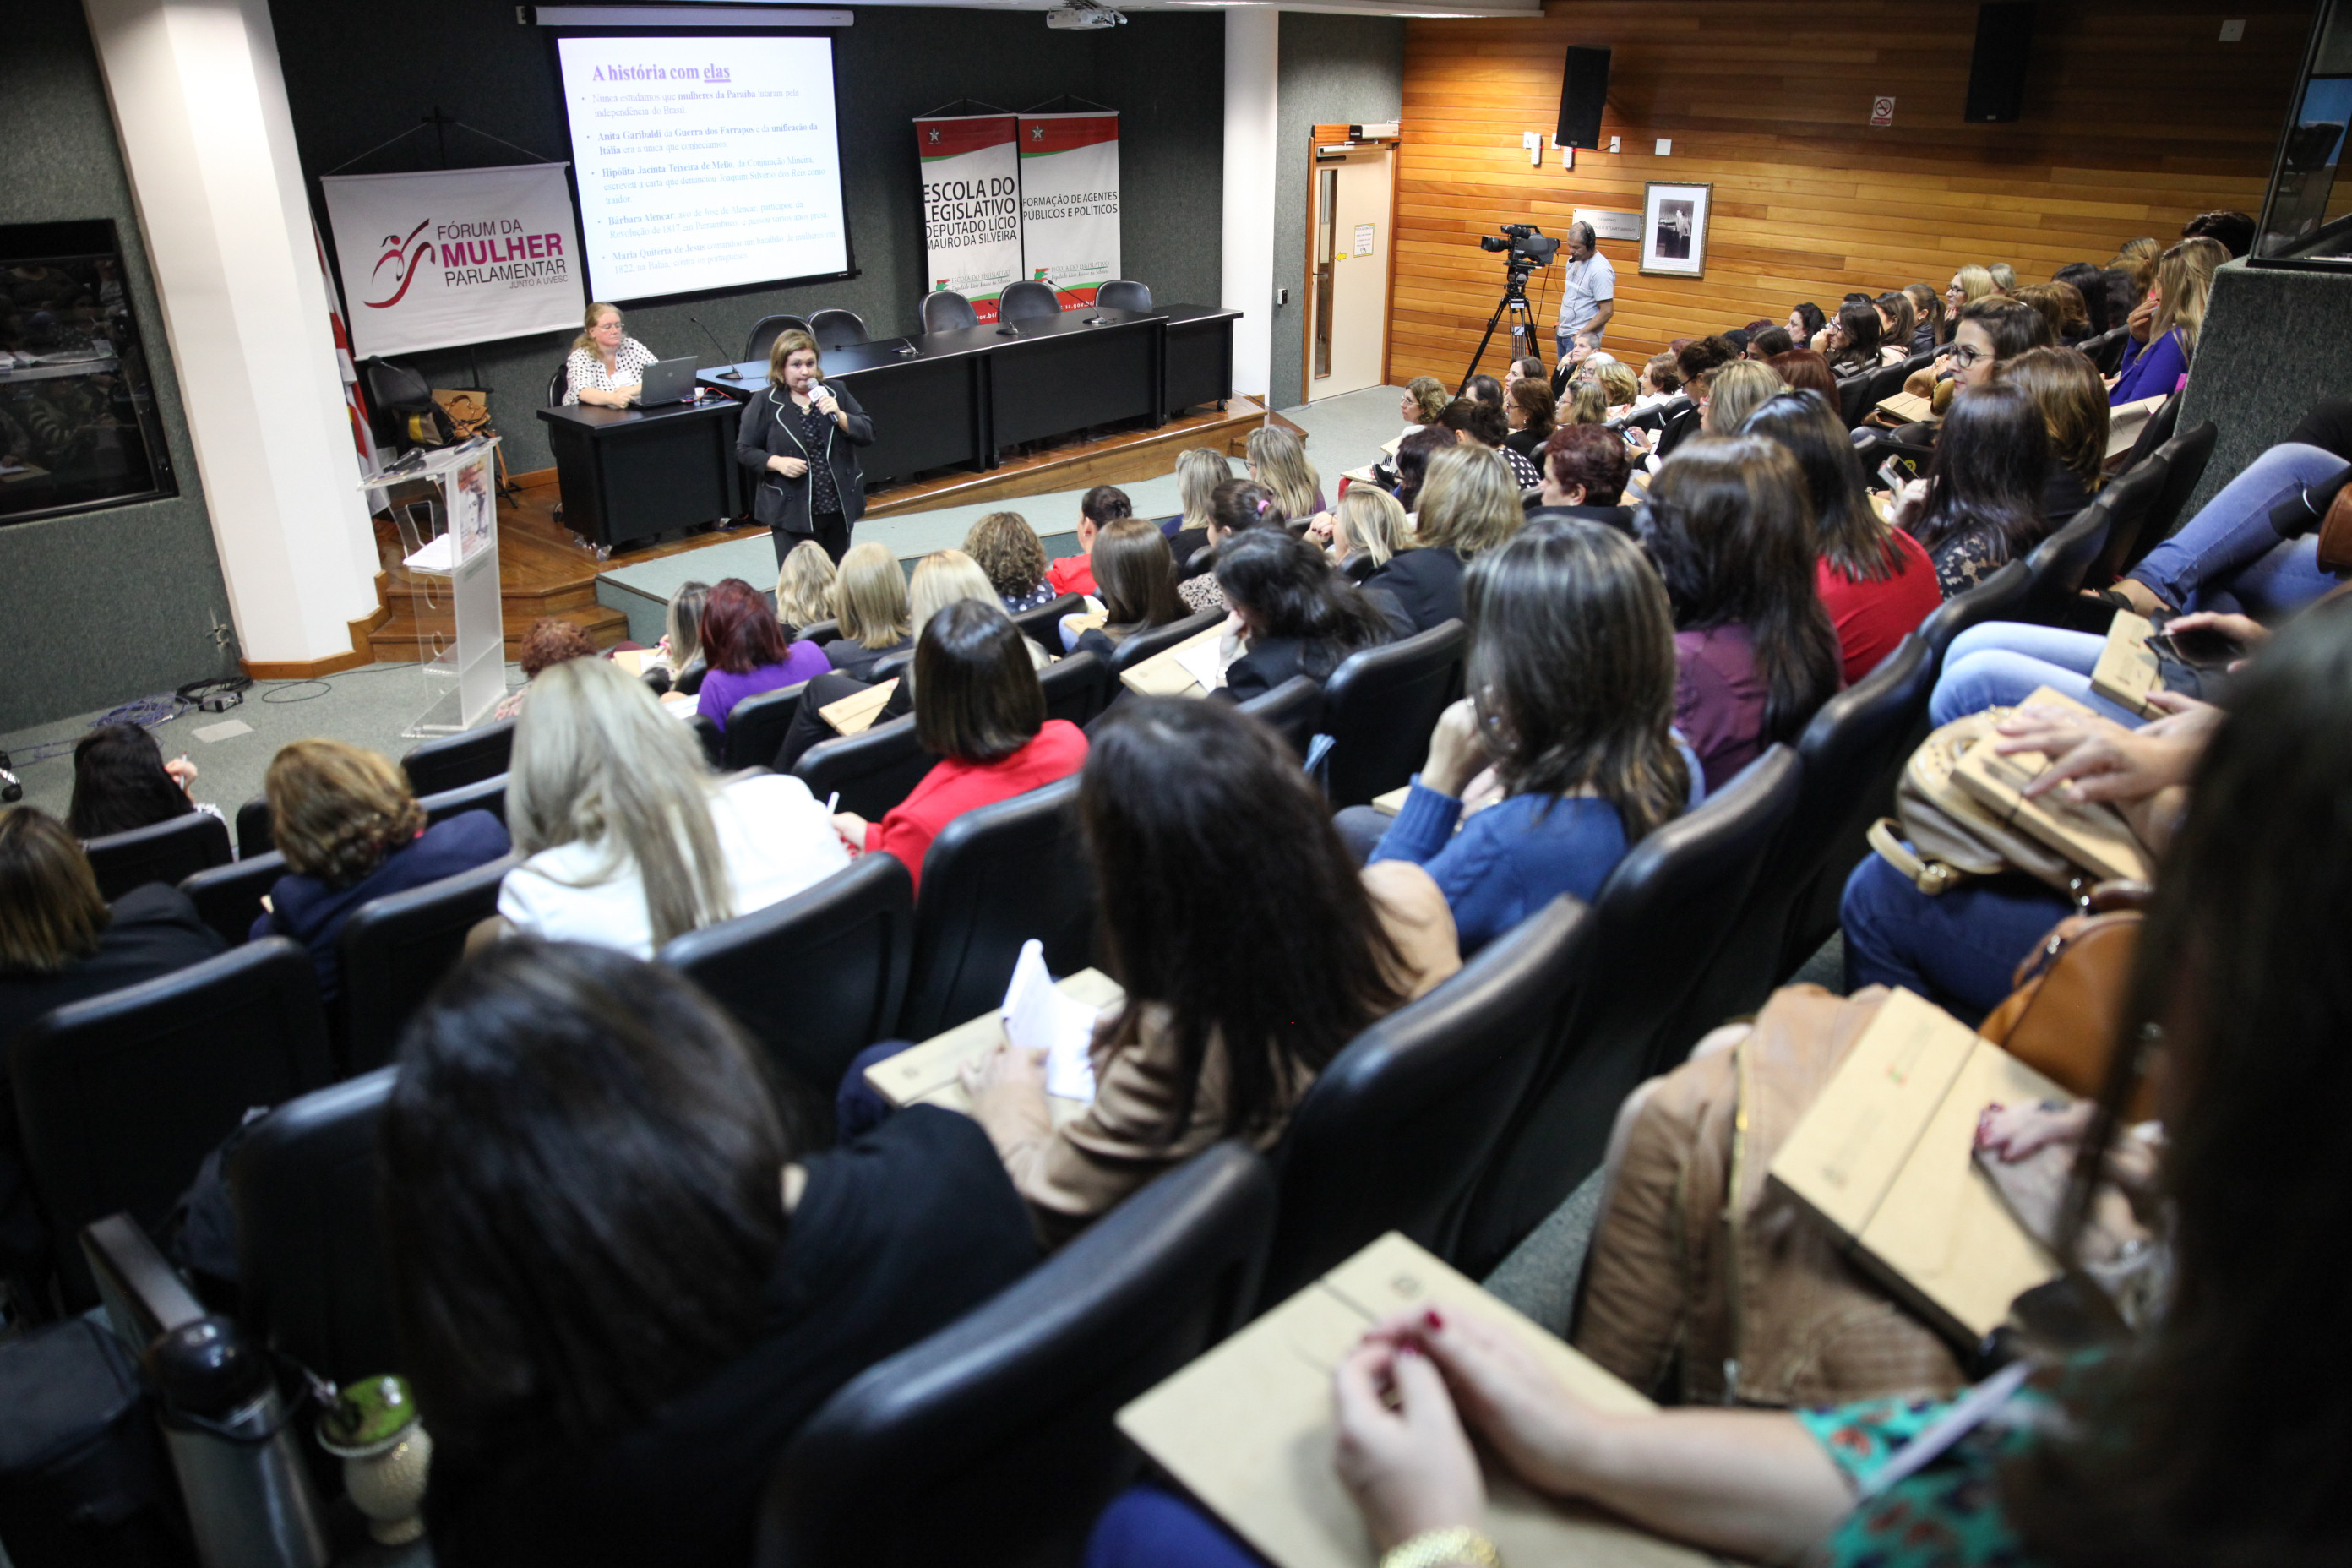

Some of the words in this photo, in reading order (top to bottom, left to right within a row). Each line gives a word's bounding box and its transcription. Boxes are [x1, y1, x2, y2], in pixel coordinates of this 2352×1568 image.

[592, 65, 605, 81] A
[607, 63, 667, 80] história
[670, 67, 700, 79] com
[704, 63, 731, 79] elas
[592, 94, 618, 103] Nunca
[620, 93, 660, 102] estudamos
[662, 92, 676, 102] que
[678, 91, 713, 101] mulheres
[715, 90, 724, 99] da
[758, 90, 782, 98] lutaram
[785, 89, 799, 99] pela
[595, 107, 649, 119] independência
[652, 106, 661, 115] do
[663, 106, 687, 115] Brasil.
[598, 132, 620, 141] Anita
[623, 129, 662, 139] Garibaldi
[664, 129, 672, 138] da
[674, 128, 703, 137] Guerra
[705, 127, 717, 135] dos
[721, 126, 754, 136] Farrapos
[761, 124, 770, 133] da
[771, 123, 807, 133] unificação
[808, 122, 818, 131] da
[599, 146, 621, 155] Itália
[666, 144, 679, 154] que
[602, 166, 634, 178] Hipólita
[637, 166, 666, 175] Jacinta
[668, 163, 699, 172] Teixeira
[737, 159, 745, 167] da
[747, 157, 785, 168] Conjuração
[603, 181, 637, 191] escreveu
[645, 179, 663, 188] carta
[665, 177, 678, 188] que
[680, 175, 716, 185] denunciou
[720, 173, 748, 182] Joaquim
[792, 168, 805, 177] Reis
[923, 179, 986, 203] ESCOLA
[991, 177, 1015, 197] DO
[1023, 193, 1069, 207] FORMAÇÃO
[1070, 194, 1081, 203] DE
[1082, 191, 1118, 203] AGENTES
[608, 215, 642, 225] Bárbara
[694, 208, 702, 216] de
[721, 206, 729, 215] de
[760, 202, 793, 212] participou
[1023, 208, 1065, 220] PÚBLICOS
[1068, 208, 1072, 217] E
[1075, 204, 1118, 216] POLÍTICOS
[437, 220, 496, 241] FÓRUM
[500, 219, 524, 235] DA
[610, 227, 649, 239] Revolução
[651, 226, 661, 234] de
[662, 223, 680, 233] 1817
[682, 223, 694, 231] em
[927, 220, 986, 239] DEPUTADO
[989, 215, 1016, 231] LÍCIO
[927, 237, 961, 251] MAURO
[963, 234, 977, 247] DA
[979, 229, 1017, 244] SILVEIRA
[441, 232, 564, 268] MULHER
[612, 251, 637, 260] Maria
[674, 245, 683, 253] de
[685, 243, 705, 253] Jesus
[444, 259, 567, 287] PARLAMENTAR
[509, 279, 535, 289] JUNTO
[536, 277, 542, 286] A
[543, 275, 569, 285] UVESC
[981, 270, 1010, 279] LEGISLATIVO
